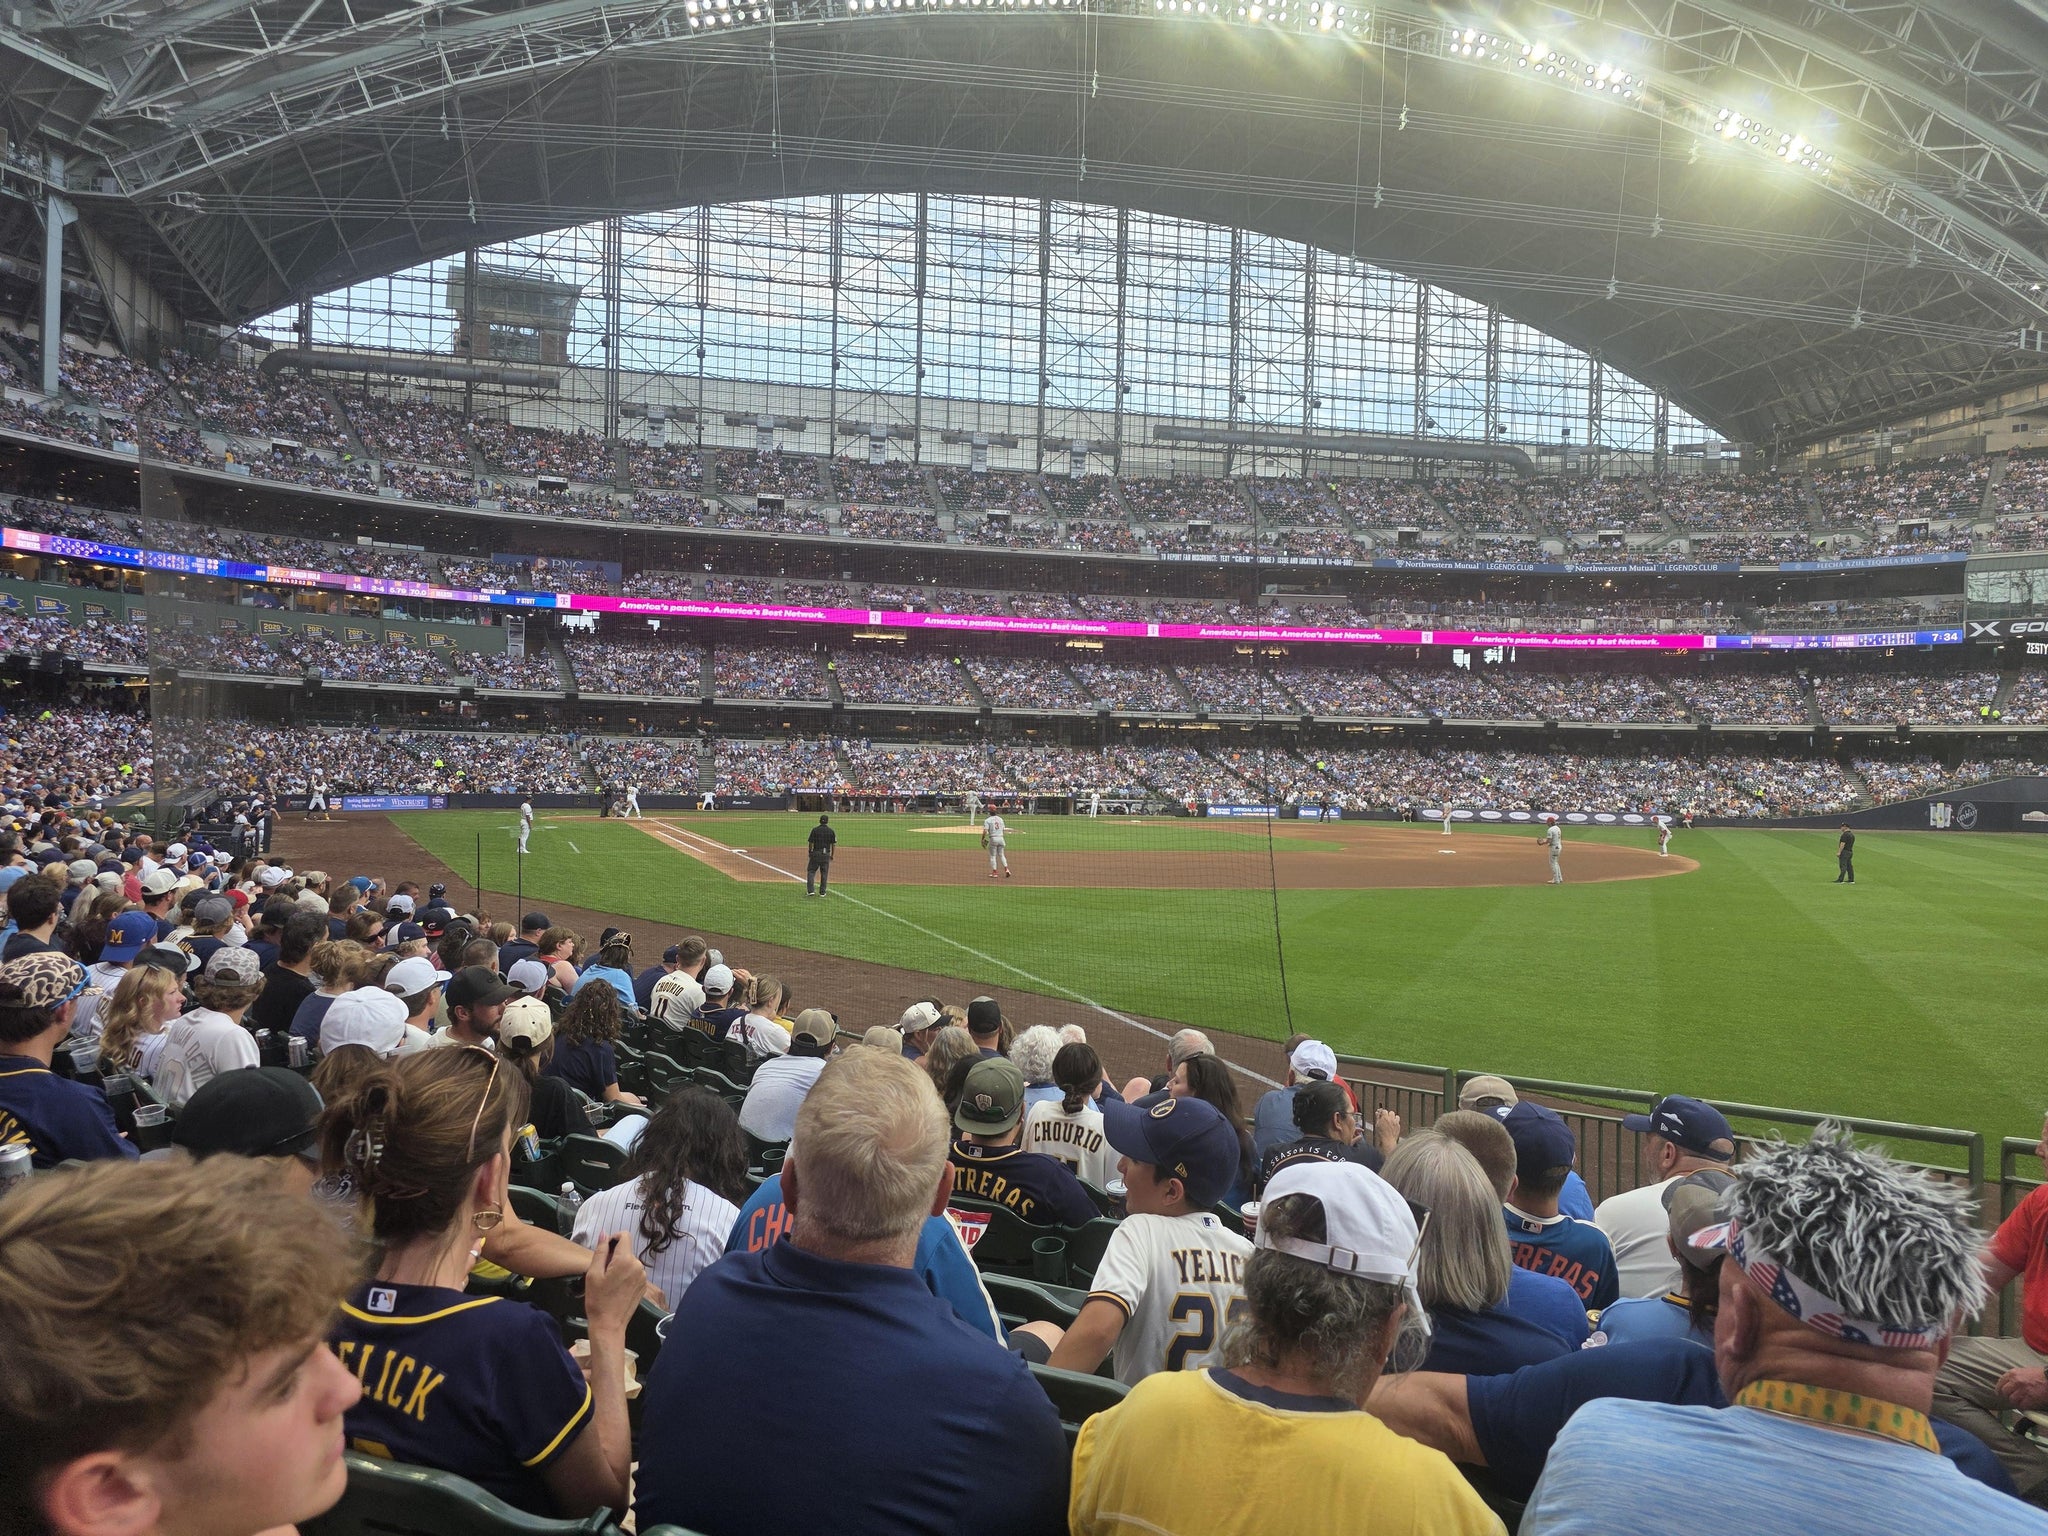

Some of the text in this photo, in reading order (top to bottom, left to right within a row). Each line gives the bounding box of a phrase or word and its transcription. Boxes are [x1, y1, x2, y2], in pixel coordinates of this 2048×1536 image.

[1405, 560, 1453, 569] Northwestern
[1454, 562, 1480, 570] Mutual
[1486, 563, 1515, 571] LEGENDS
[1867, 557, 1899, 566] TEQUILA
[1901, 556, 1923, 564] PATIO
[619, 601, 827, 619] America's pastime. America's Best Network.
[924, 617, 1109, 632] America's pastime. America's Best Network.
[1199, 628, 1383, 641] America's pastime. America's Best Network.
[1472, 635, 1660, 646] America's pastime. America's Best Network.
[1931, 632, 1958, 642] 7:34
[2026, 642, 2048, 655] ZESTY
[994, 821, 1000, 831] 3
[109, 929, 124, 944] M
[655, 980, 685, 997] CHOURIO
[1034, 1121, 1104, 1154] CHOURIO
[1270, 1146, 1305, 1168] SEASON
[1308, 1146, 1321, 1155] IS
[950, 1165, 1035, 1217] TRERAS
